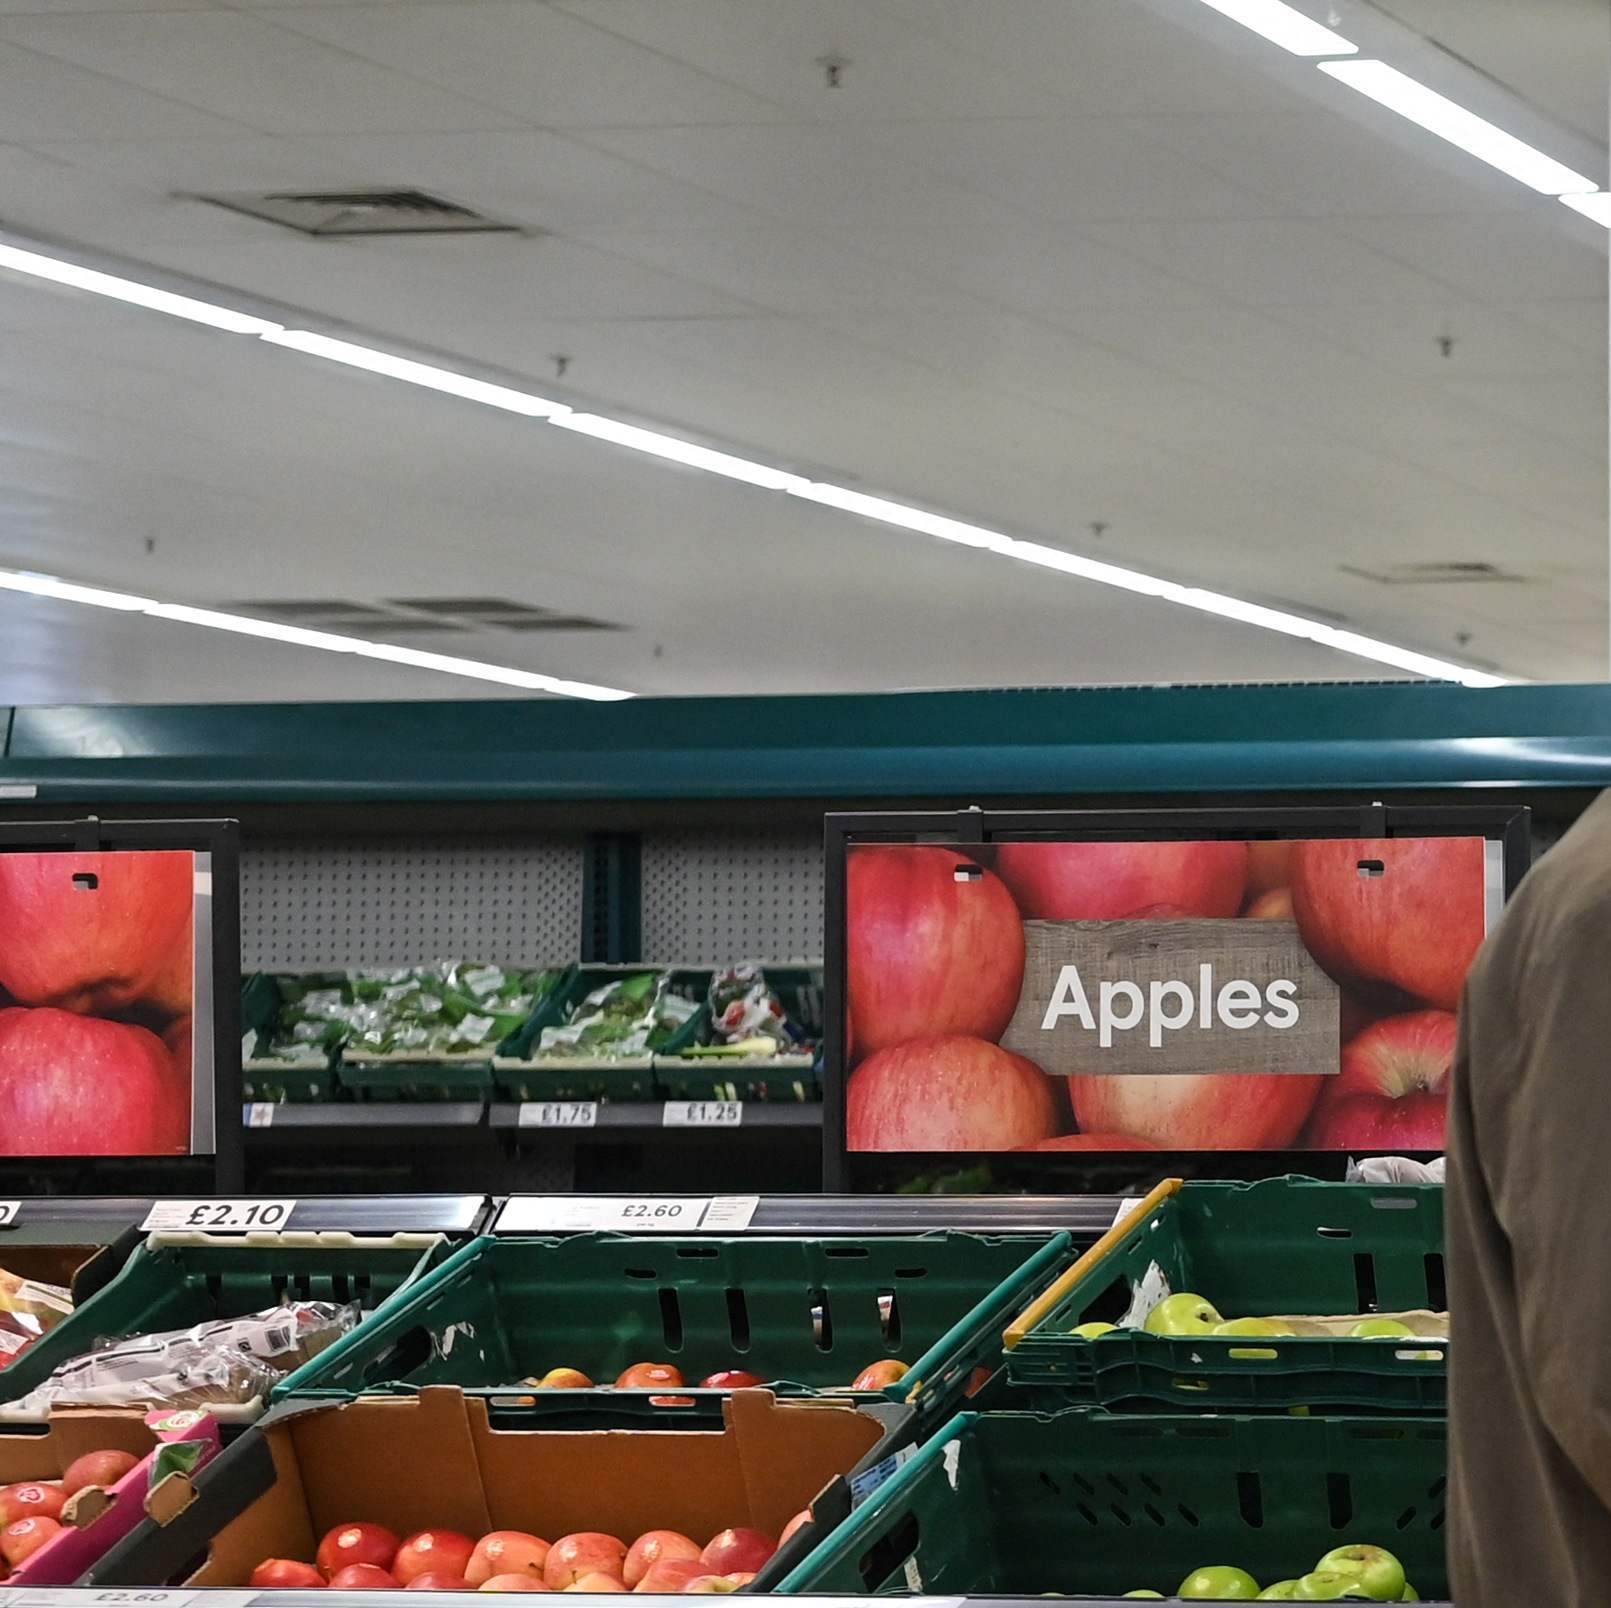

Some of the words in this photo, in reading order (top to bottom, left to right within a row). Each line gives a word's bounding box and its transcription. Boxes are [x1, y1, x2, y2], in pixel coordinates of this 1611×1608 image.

[1041, 963, 1300, 1048] Apples
[541, 1105, 593, 1121] £1.75
[686, 1104, 739, 1121] £1.25
[186, 1204, 285, 1225] £2.10
[621, 1204, 683, 1218] £2.60
[96, 1593, 169, 1601] £2.60
